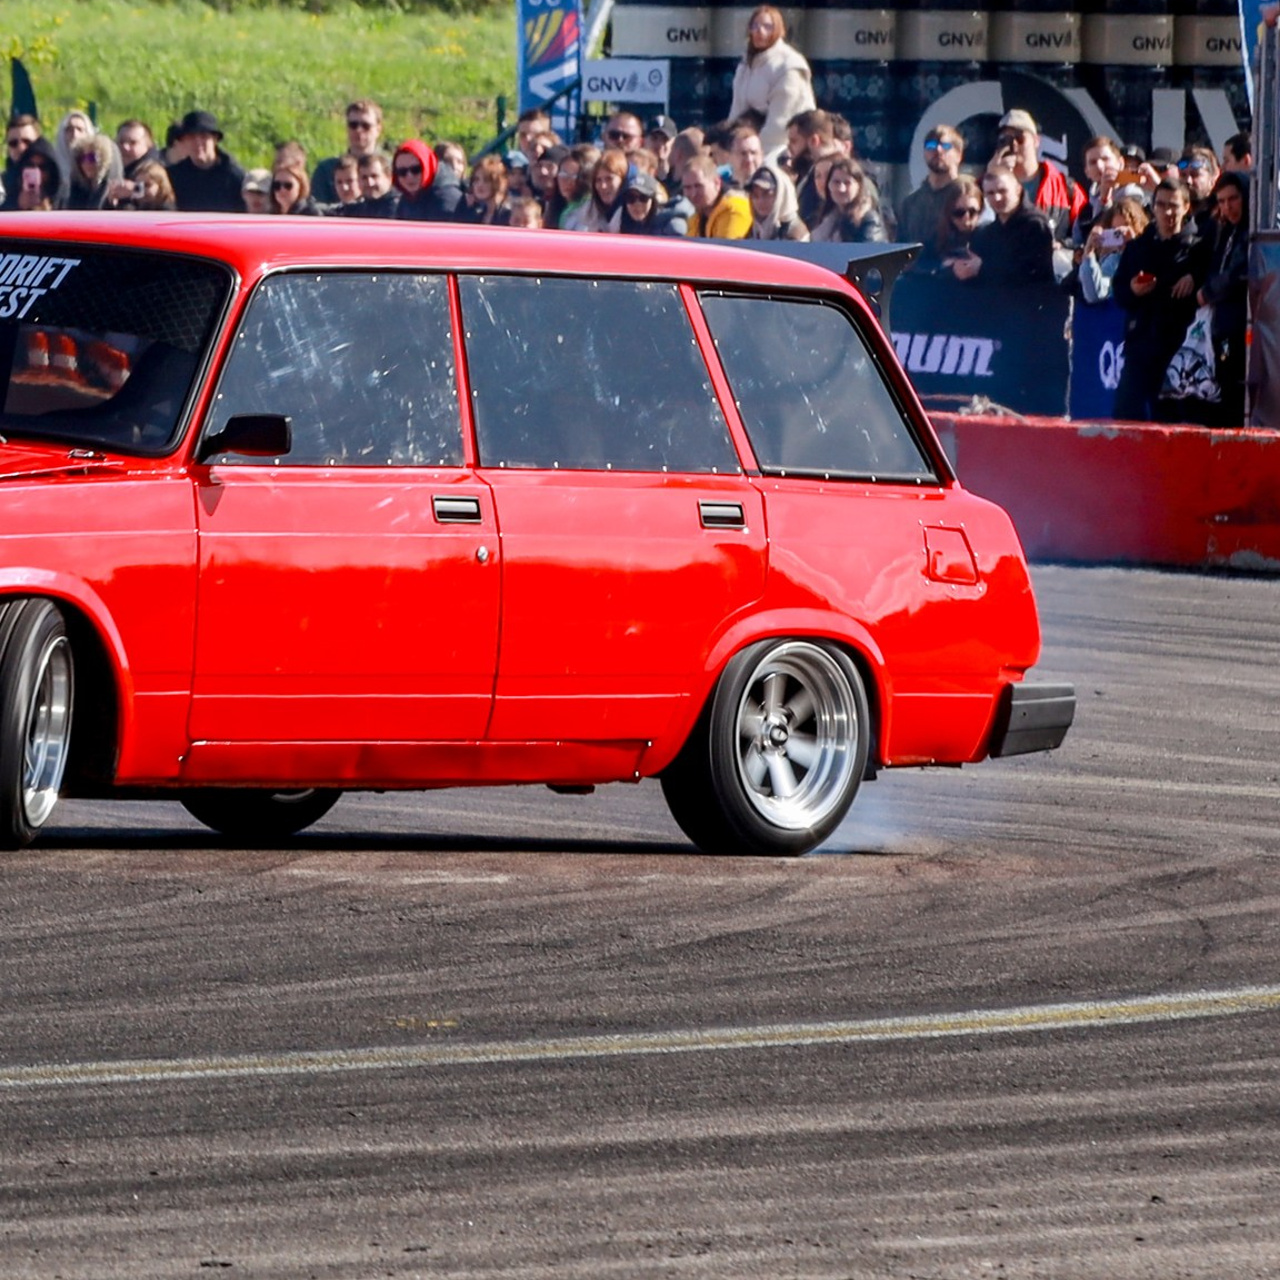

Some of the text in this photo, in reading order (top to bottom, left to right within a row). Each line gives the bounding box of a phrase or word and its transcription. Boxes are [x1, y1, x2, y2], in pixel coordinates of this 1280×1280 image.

[667, 27, 700, 42] GNV
[855, 30, 888, 45] GNV
[939, 31, 975, 47] GNV
[1026, 32, 1064, 48] GNV
[1132, 36, 1165, 50] GNV
[587, 77, 626, 92] GNV
